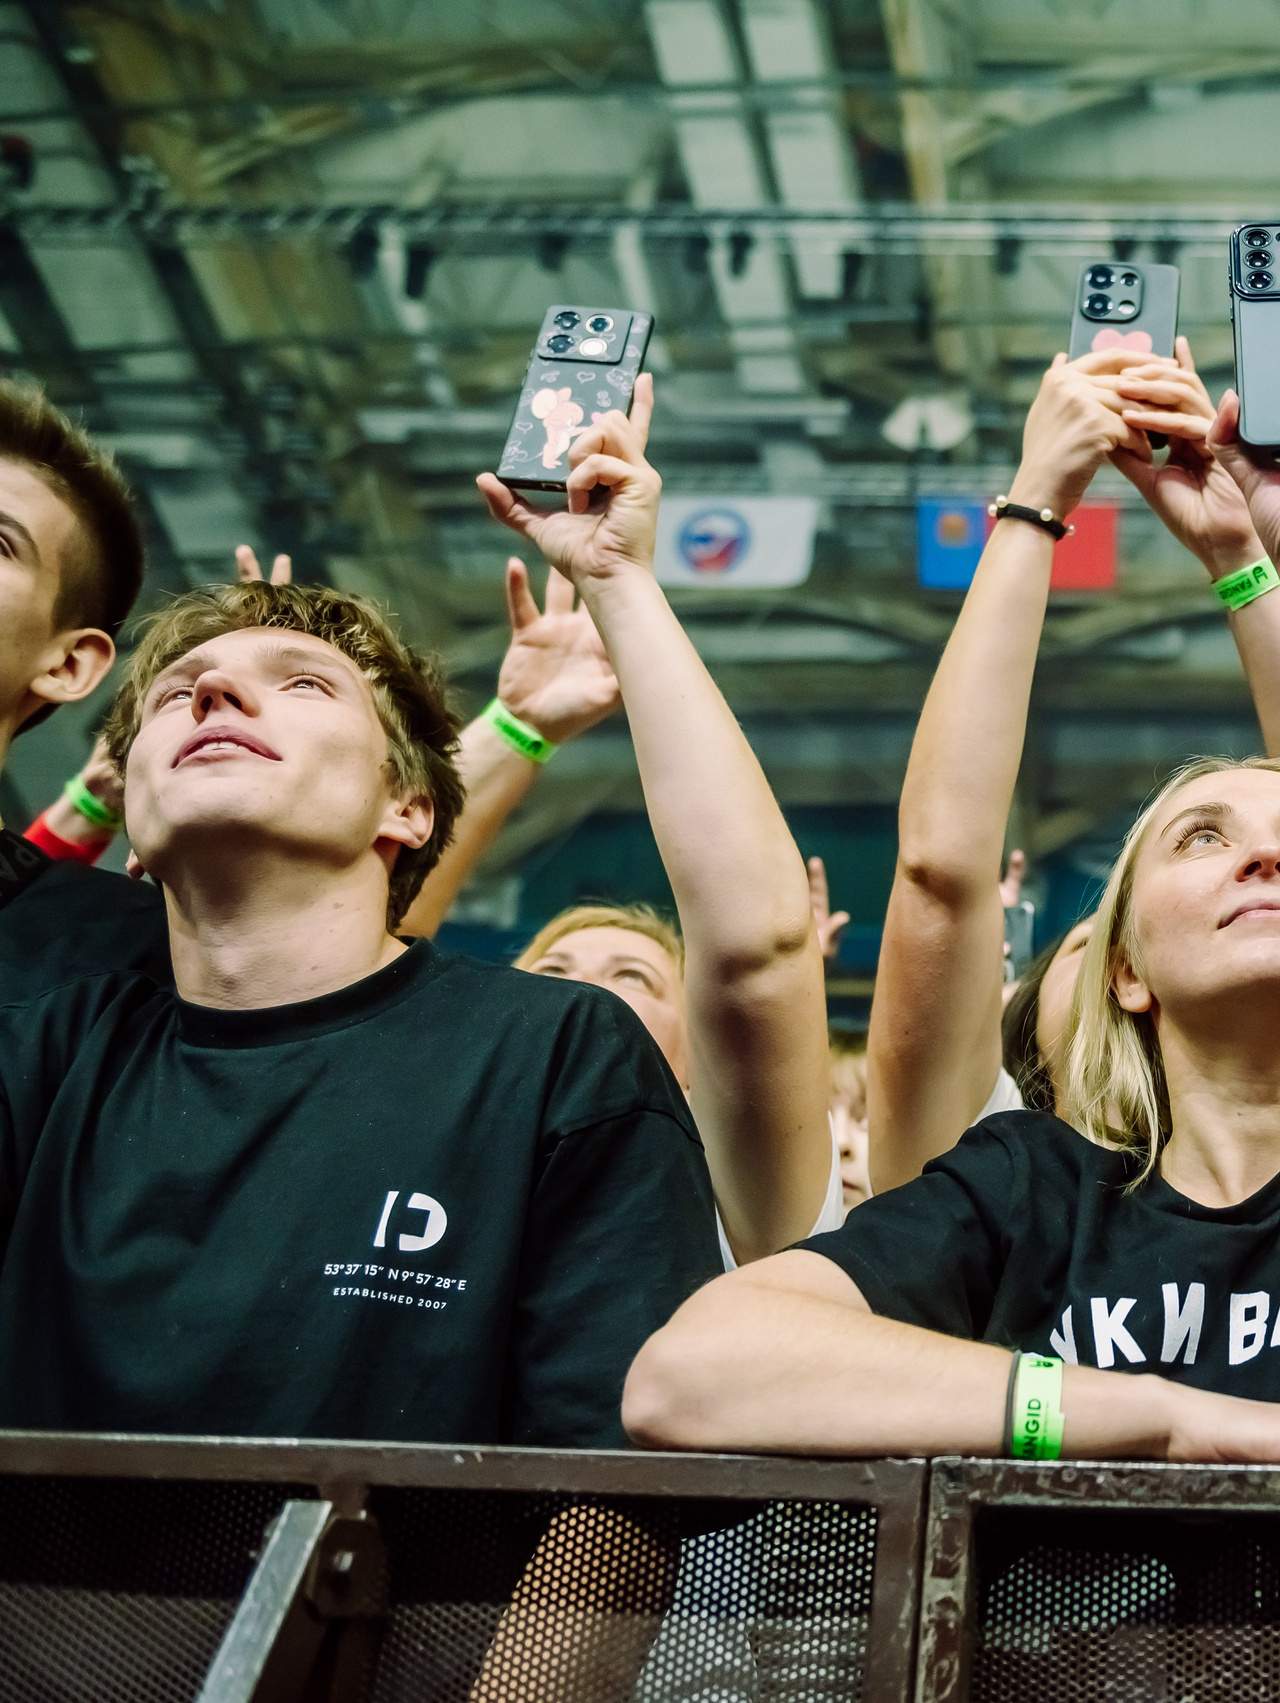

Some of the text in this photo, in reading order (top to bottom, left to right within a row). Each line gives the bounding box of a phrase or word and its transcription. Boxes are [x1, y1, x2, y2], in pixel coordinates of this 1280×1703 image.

[333, 1287, 447, 1310] ESTABLISHED 2007
[1049, 1282, 1205, 1368] УКИ
[1022, 1398, 1042, 1460] ANGID
